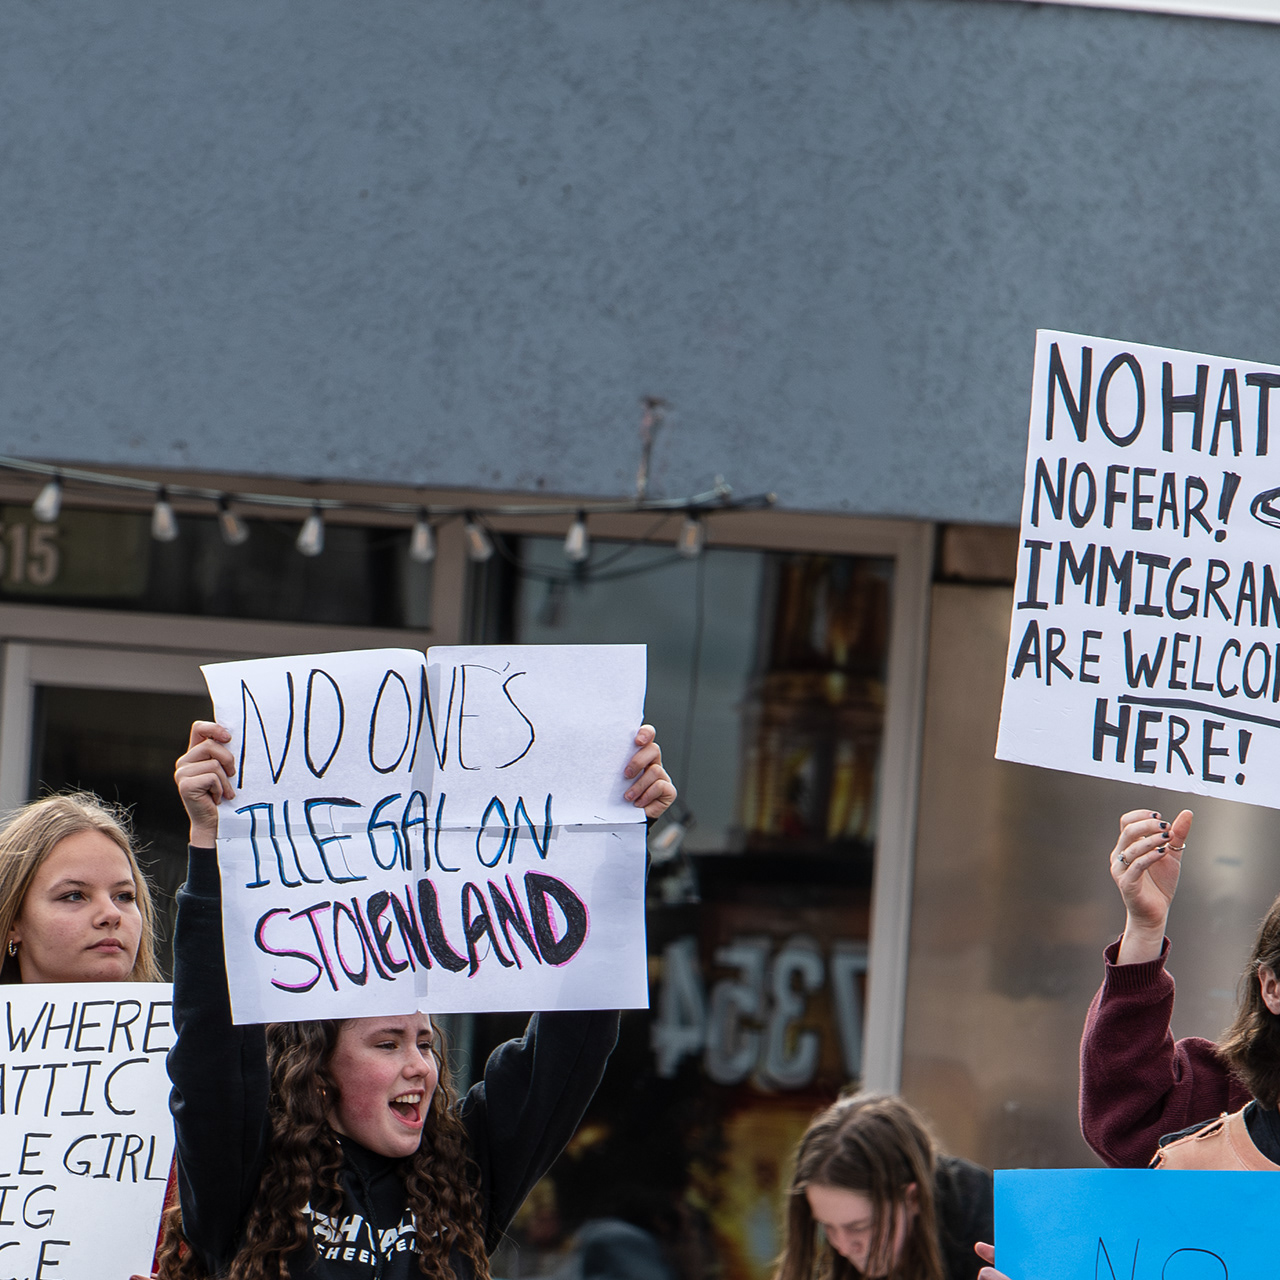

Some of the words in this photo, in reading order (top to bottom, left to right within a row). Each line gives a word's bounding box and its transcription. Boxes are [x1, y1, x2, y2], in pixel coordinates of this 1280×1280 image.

[1045, 342, 1146, 447] NO
[1031, 456, 1097, 528] NO
[1104, 464, 1242, 543] FEAR!
[1012, 620, 1104, 686] ARE
[238, 668, 345, 789] NO
[369, 661, 536, 774] ONE'S
[1092, 697, 1253, 786] HERE!
[234, 790, 461, 889] ILLEGAL
[475, 792, 553, 868] ON
[63, 1132, 169, 1184] GIRL
